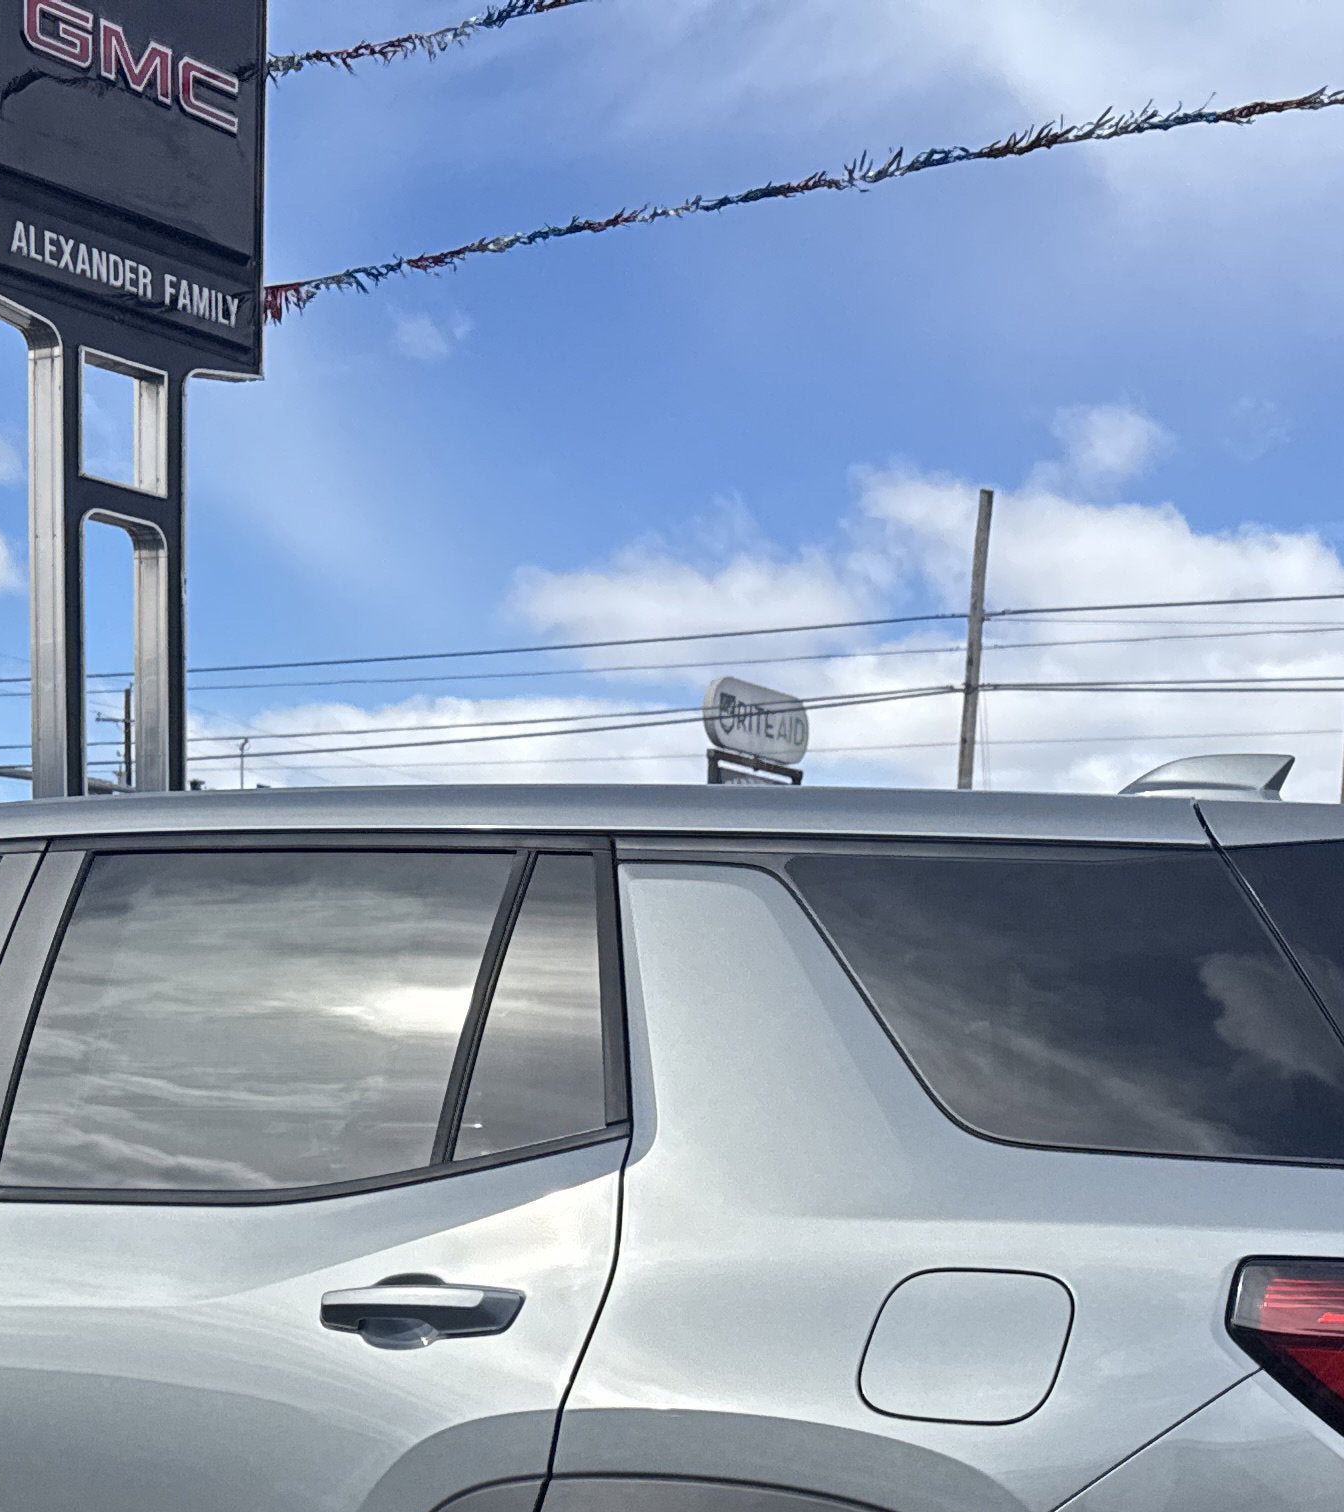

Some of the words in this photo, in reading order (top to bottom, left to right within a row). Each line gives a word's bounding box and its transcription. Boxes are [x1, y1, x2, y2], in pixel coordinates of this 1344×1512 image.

[23, 0, 239, 134] GMC
[10, 220, 153, 300] ALEXANDER
[163, 273, 239, 328] FAMILY
[776, 716, 805, 746] AID
